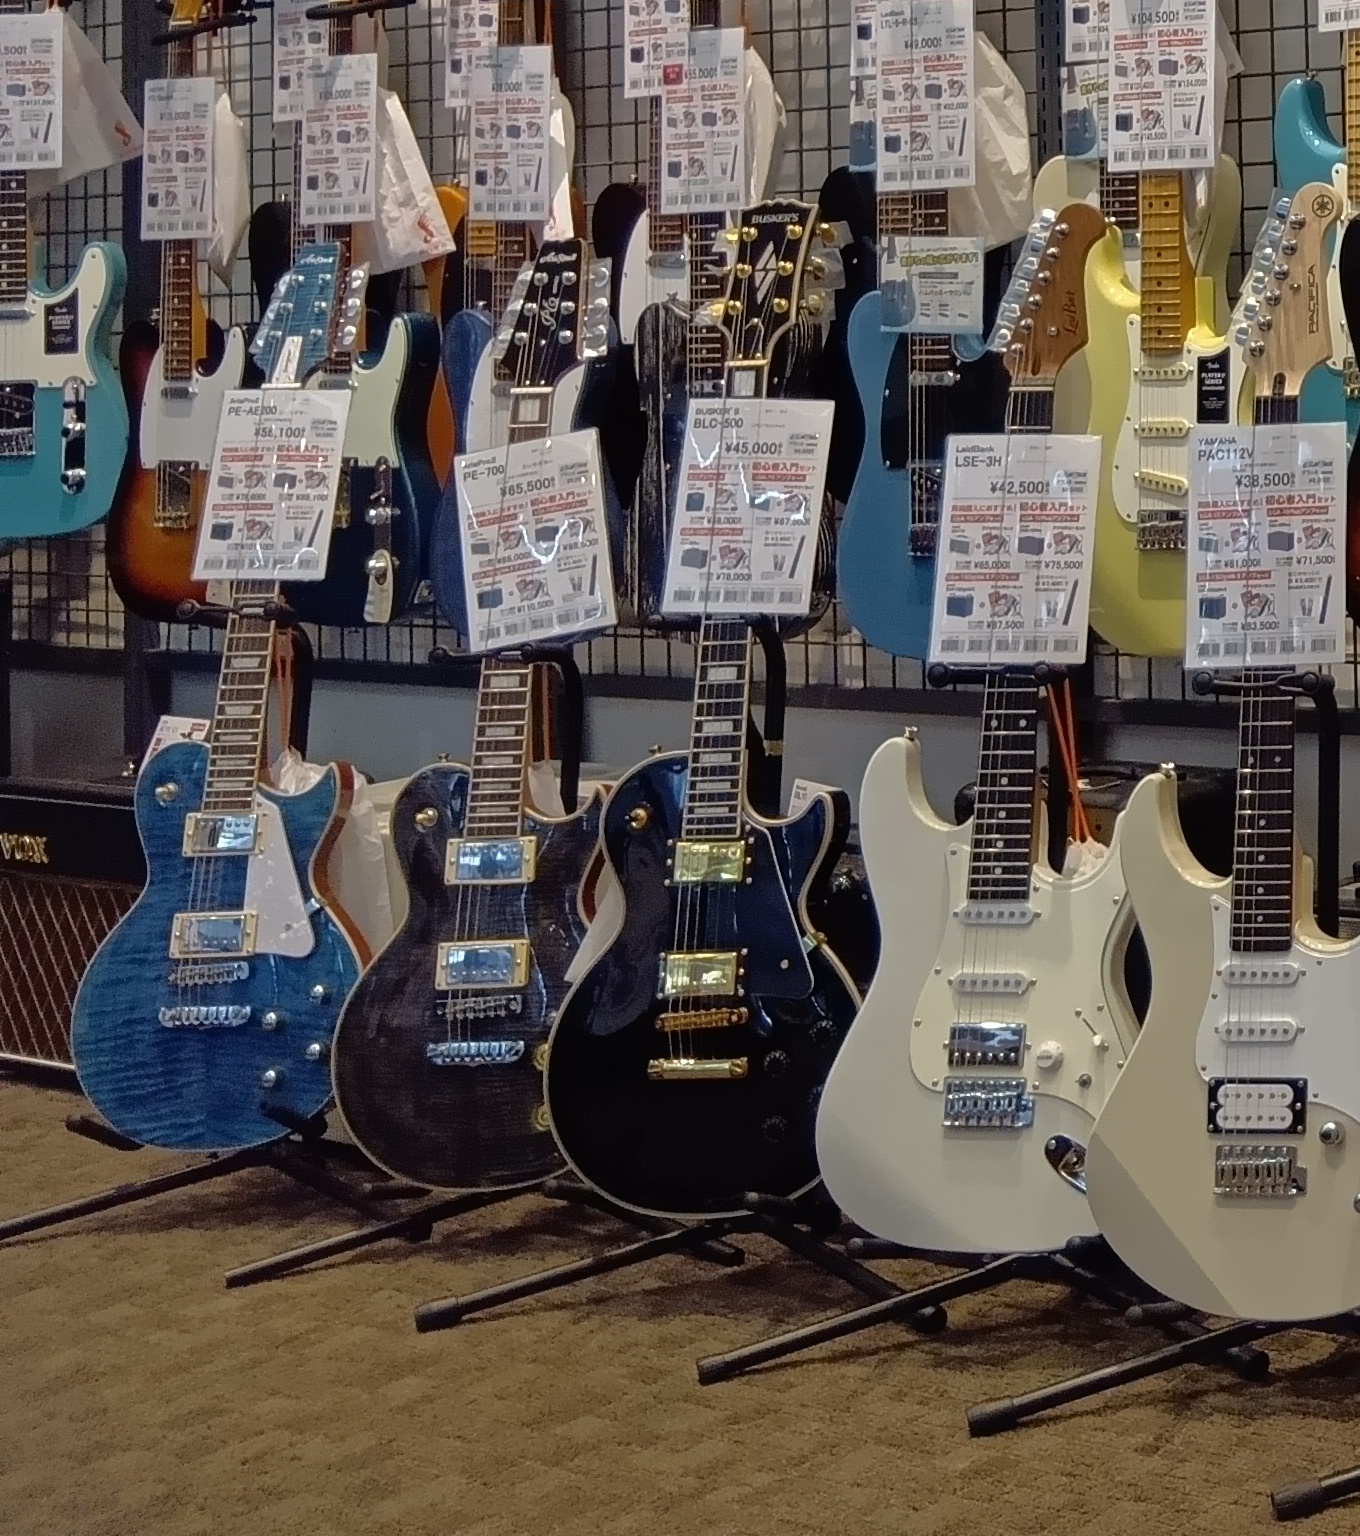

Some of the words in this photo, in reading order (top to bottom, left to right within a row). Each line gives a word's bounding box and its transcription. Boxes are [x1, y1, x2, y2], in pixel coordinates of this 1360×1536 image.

[752, 212, 799, 224] BUSKER'S
[1309, 264, 1317, 334] PACIFICA
[693, 417, 744, 429] BLC-500
[1198, 436, 1237, 445] YAMAHA
[725, 442, 777, 455] ¥45,000
[1197, 447, 1254, 461] PAC112V
[955, 456, 1002, 467] LSE-3H
[463, 465, 504, 482] PE-700
[1235, 472, 1290, 488] ¥38,500
[990, 481, 1045, 495] ¥42,500
[0, 832, 49, 864] VOX
